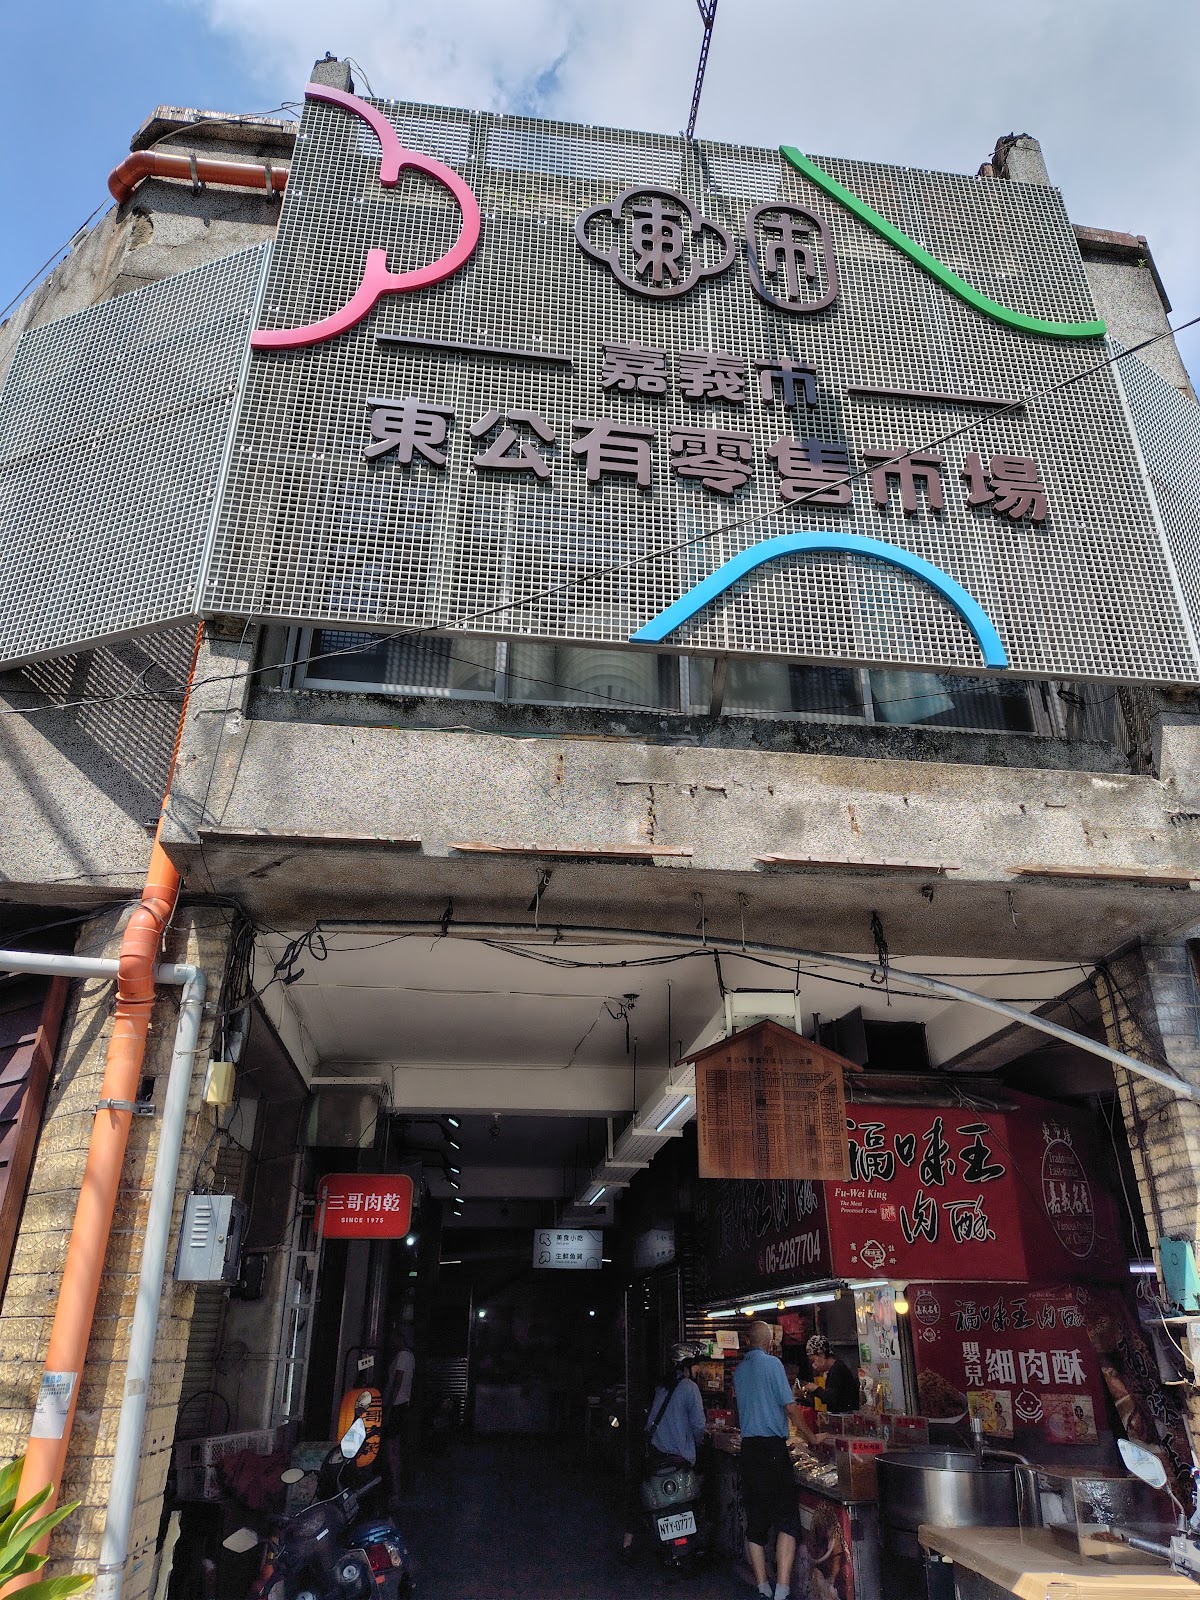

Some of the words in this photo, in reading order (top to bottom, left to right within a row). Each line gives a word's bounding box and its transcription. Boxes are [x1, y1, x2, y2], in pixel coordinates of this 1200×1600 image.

[601, 341, 818, 408] 嘉義市
[364, 398, 1050, 526] 東公有零售市場
[327, 1192, 400, 1212] 三哥肉乾
[834, 1187, 866, 1199] Fu-Wei
[867, 1189, 887, 1201] King
[556, 1234, 584, 1242] 美食小吃
[765, 1229, 820, 1274] 05-2287704
[962, 1342, 984, 1386] 嬰兒
[985, 1348, 1087, 1385] 細肉酥
[660, 1516, 693, 1536] NYY-0777
